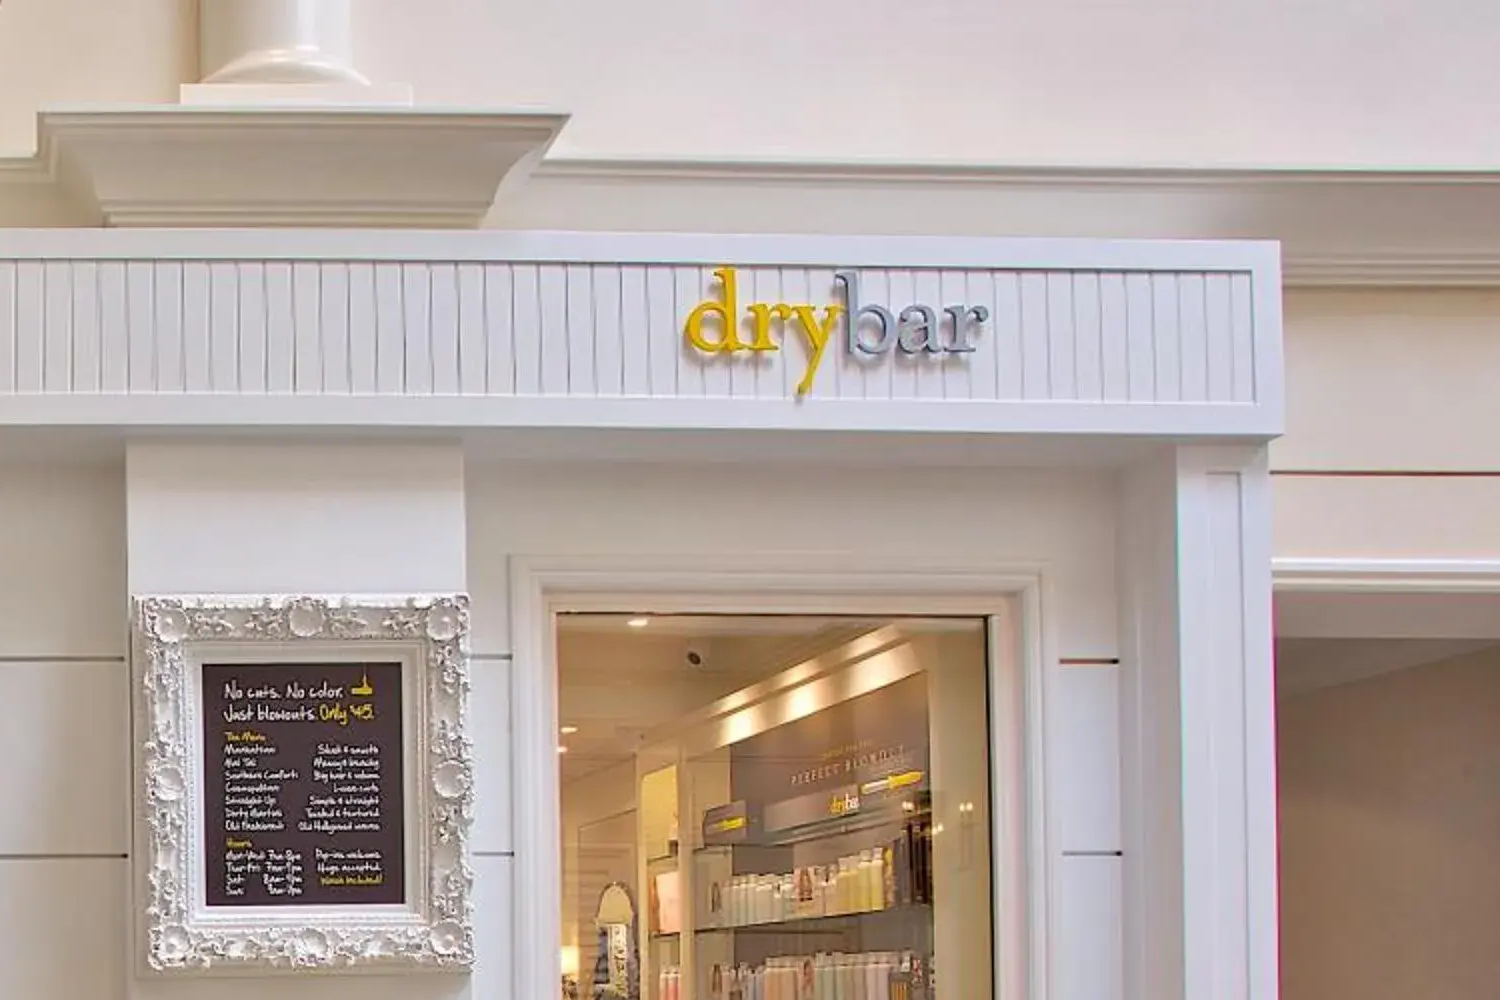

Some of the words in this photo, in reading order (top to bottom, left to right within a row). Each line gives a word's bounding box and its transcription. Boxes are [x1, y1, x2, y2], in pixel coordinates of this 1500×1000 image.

[684, 267, 989, 395] drybar
[224, 680, 243, 699] No
[247, 684, 281, 699] cuts.
[286, 681, 305, 699] No
[309, 680, 343, 699] color.
[223, 704, 255, 722] Just
[319, 703, 348, 725] Only
